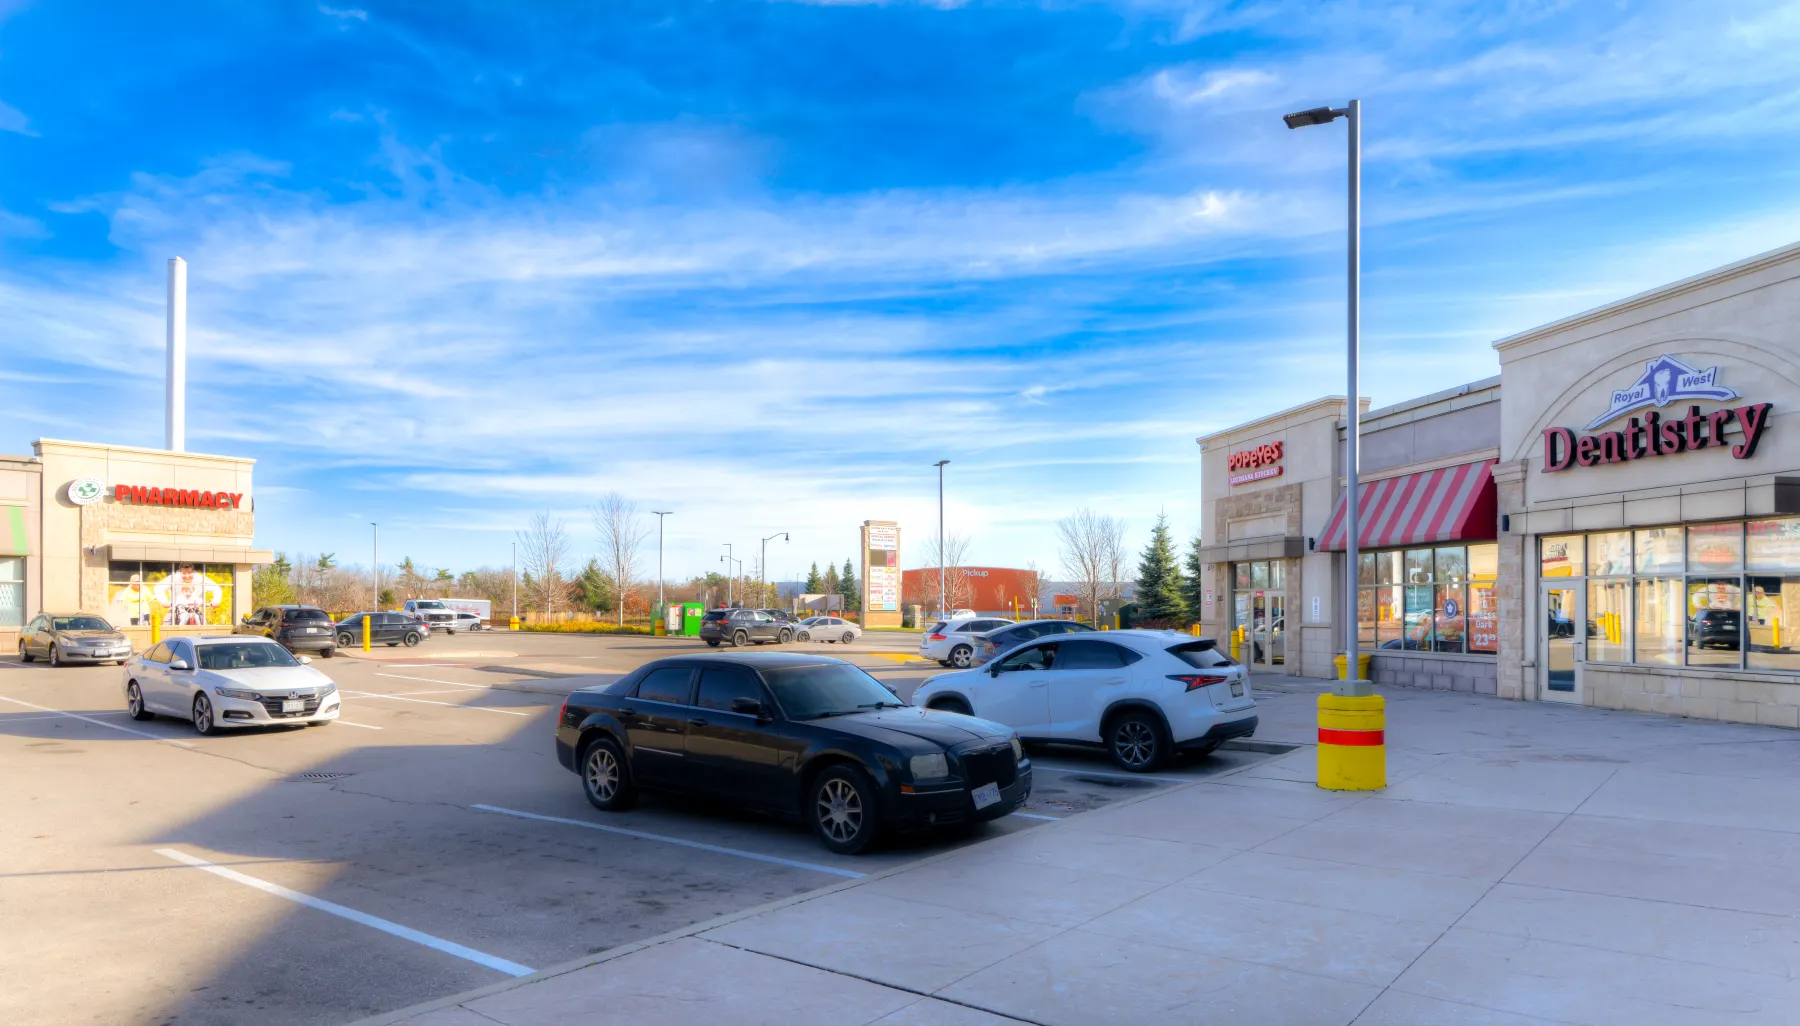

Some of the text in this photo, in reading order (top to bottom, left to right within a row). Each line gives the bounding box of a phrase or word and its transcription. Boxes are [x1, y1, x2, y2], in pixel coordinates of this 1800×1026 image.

[1613, 371, 1712, 404] Royal West
[1541, 403, 1773, 473] Dentistry
[114, 484, 243, 510] PHARMACY
[962, 569, 988, 578] Pickup
[1476, 620, 1493, 629] Dark
